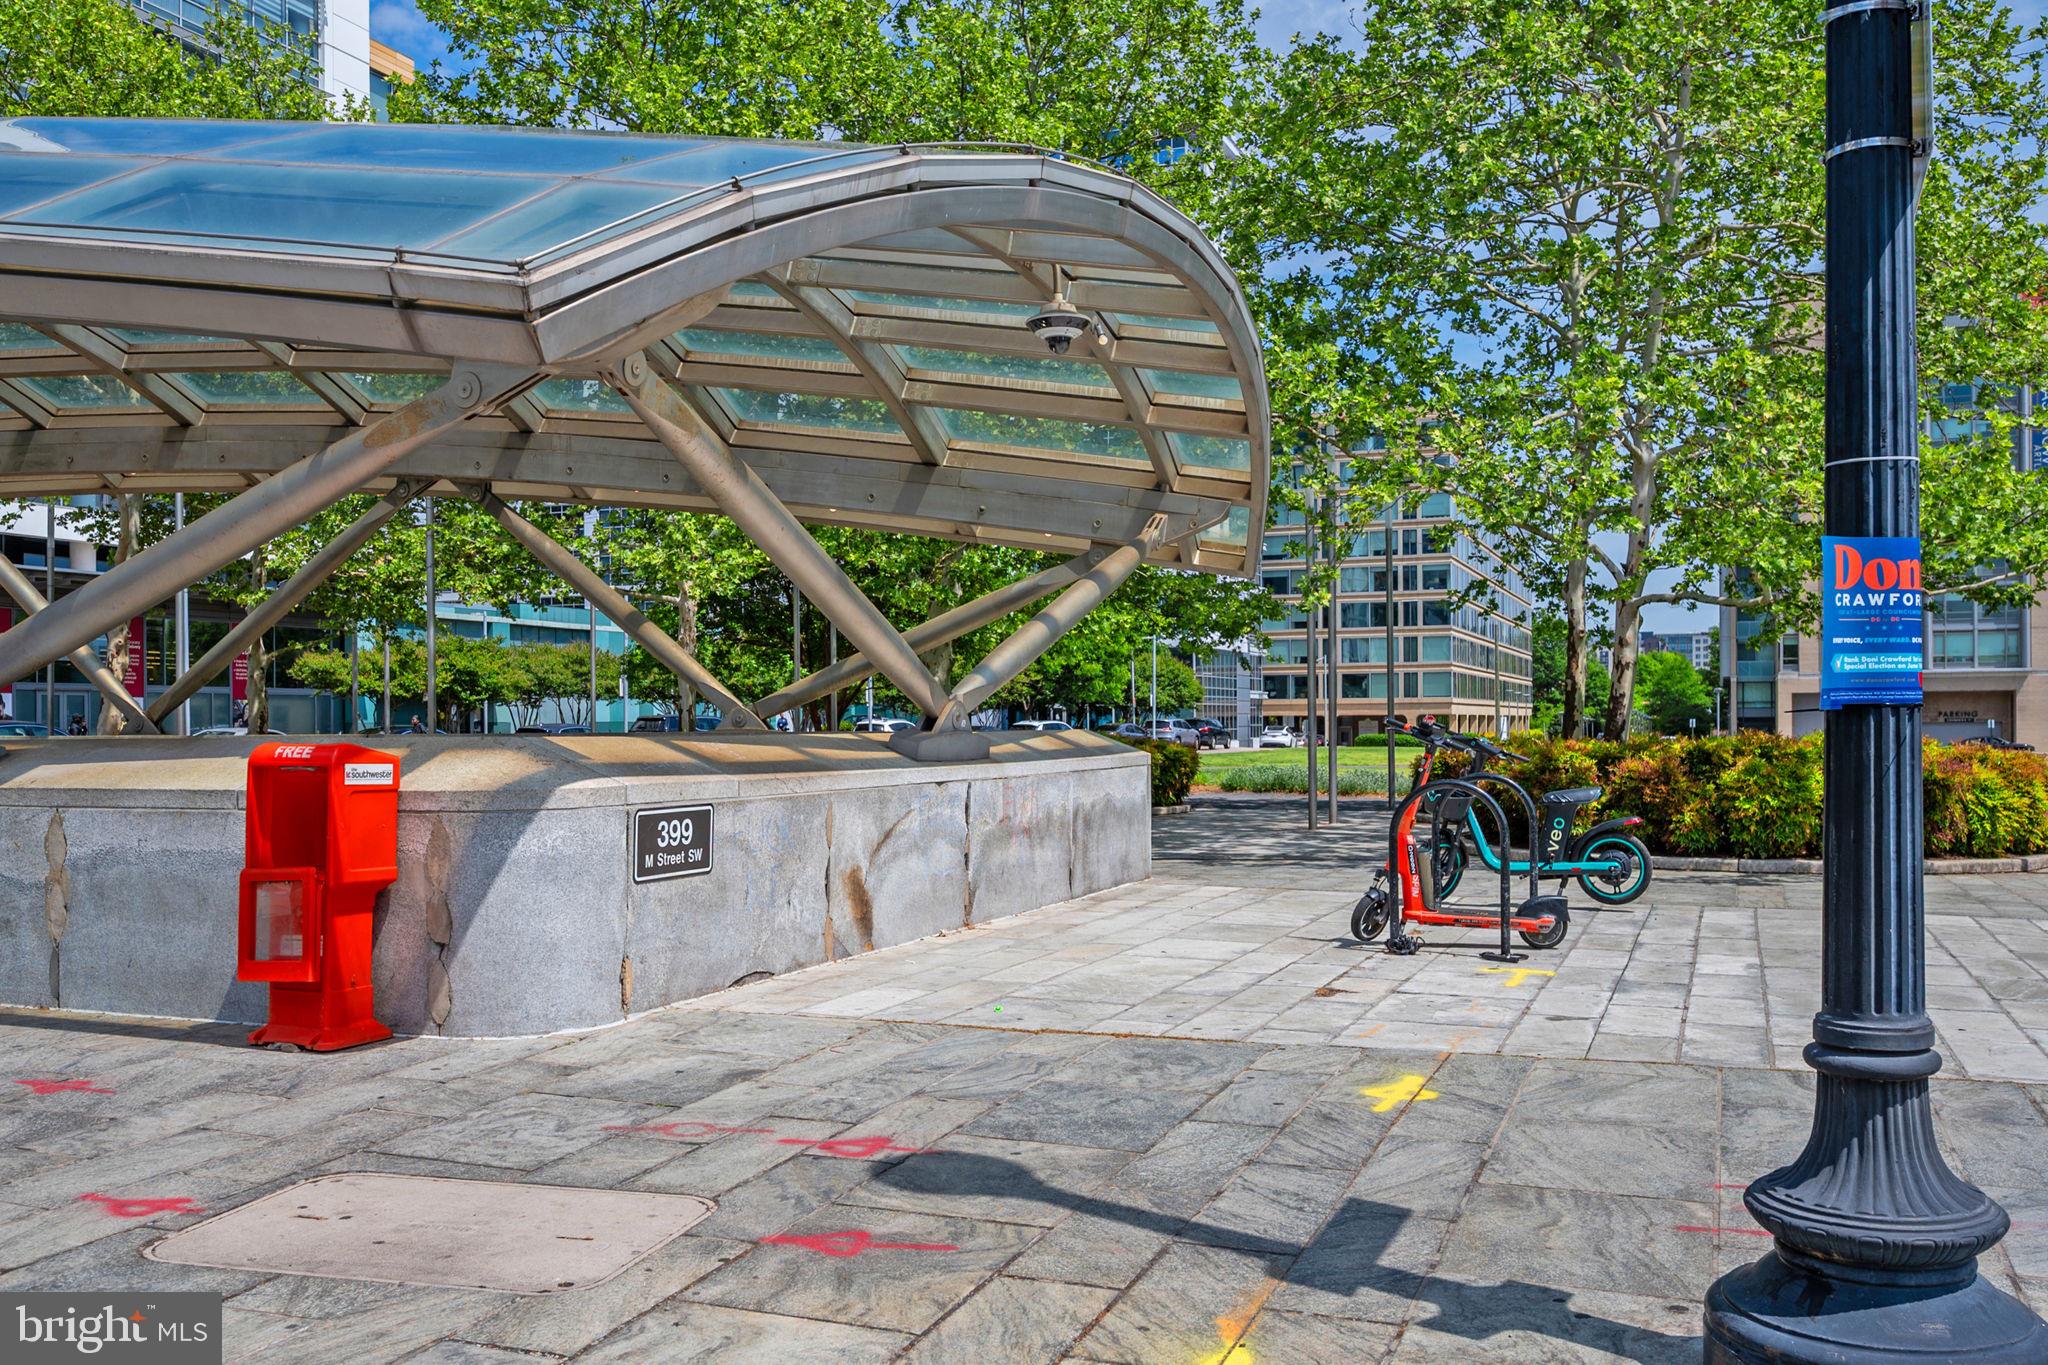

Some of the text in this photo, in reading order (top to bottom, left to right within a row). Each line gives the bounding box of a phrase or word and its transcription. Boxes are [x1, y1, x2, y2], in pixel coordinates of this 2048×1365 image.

[274, 746, 316, 759] FREE
[351, 770, 392, 779] southwester
[657, 818, 693, 848] 399
[1547, 817, 1565, 851] veo
[645, 848, 703, 868] M Street SW
